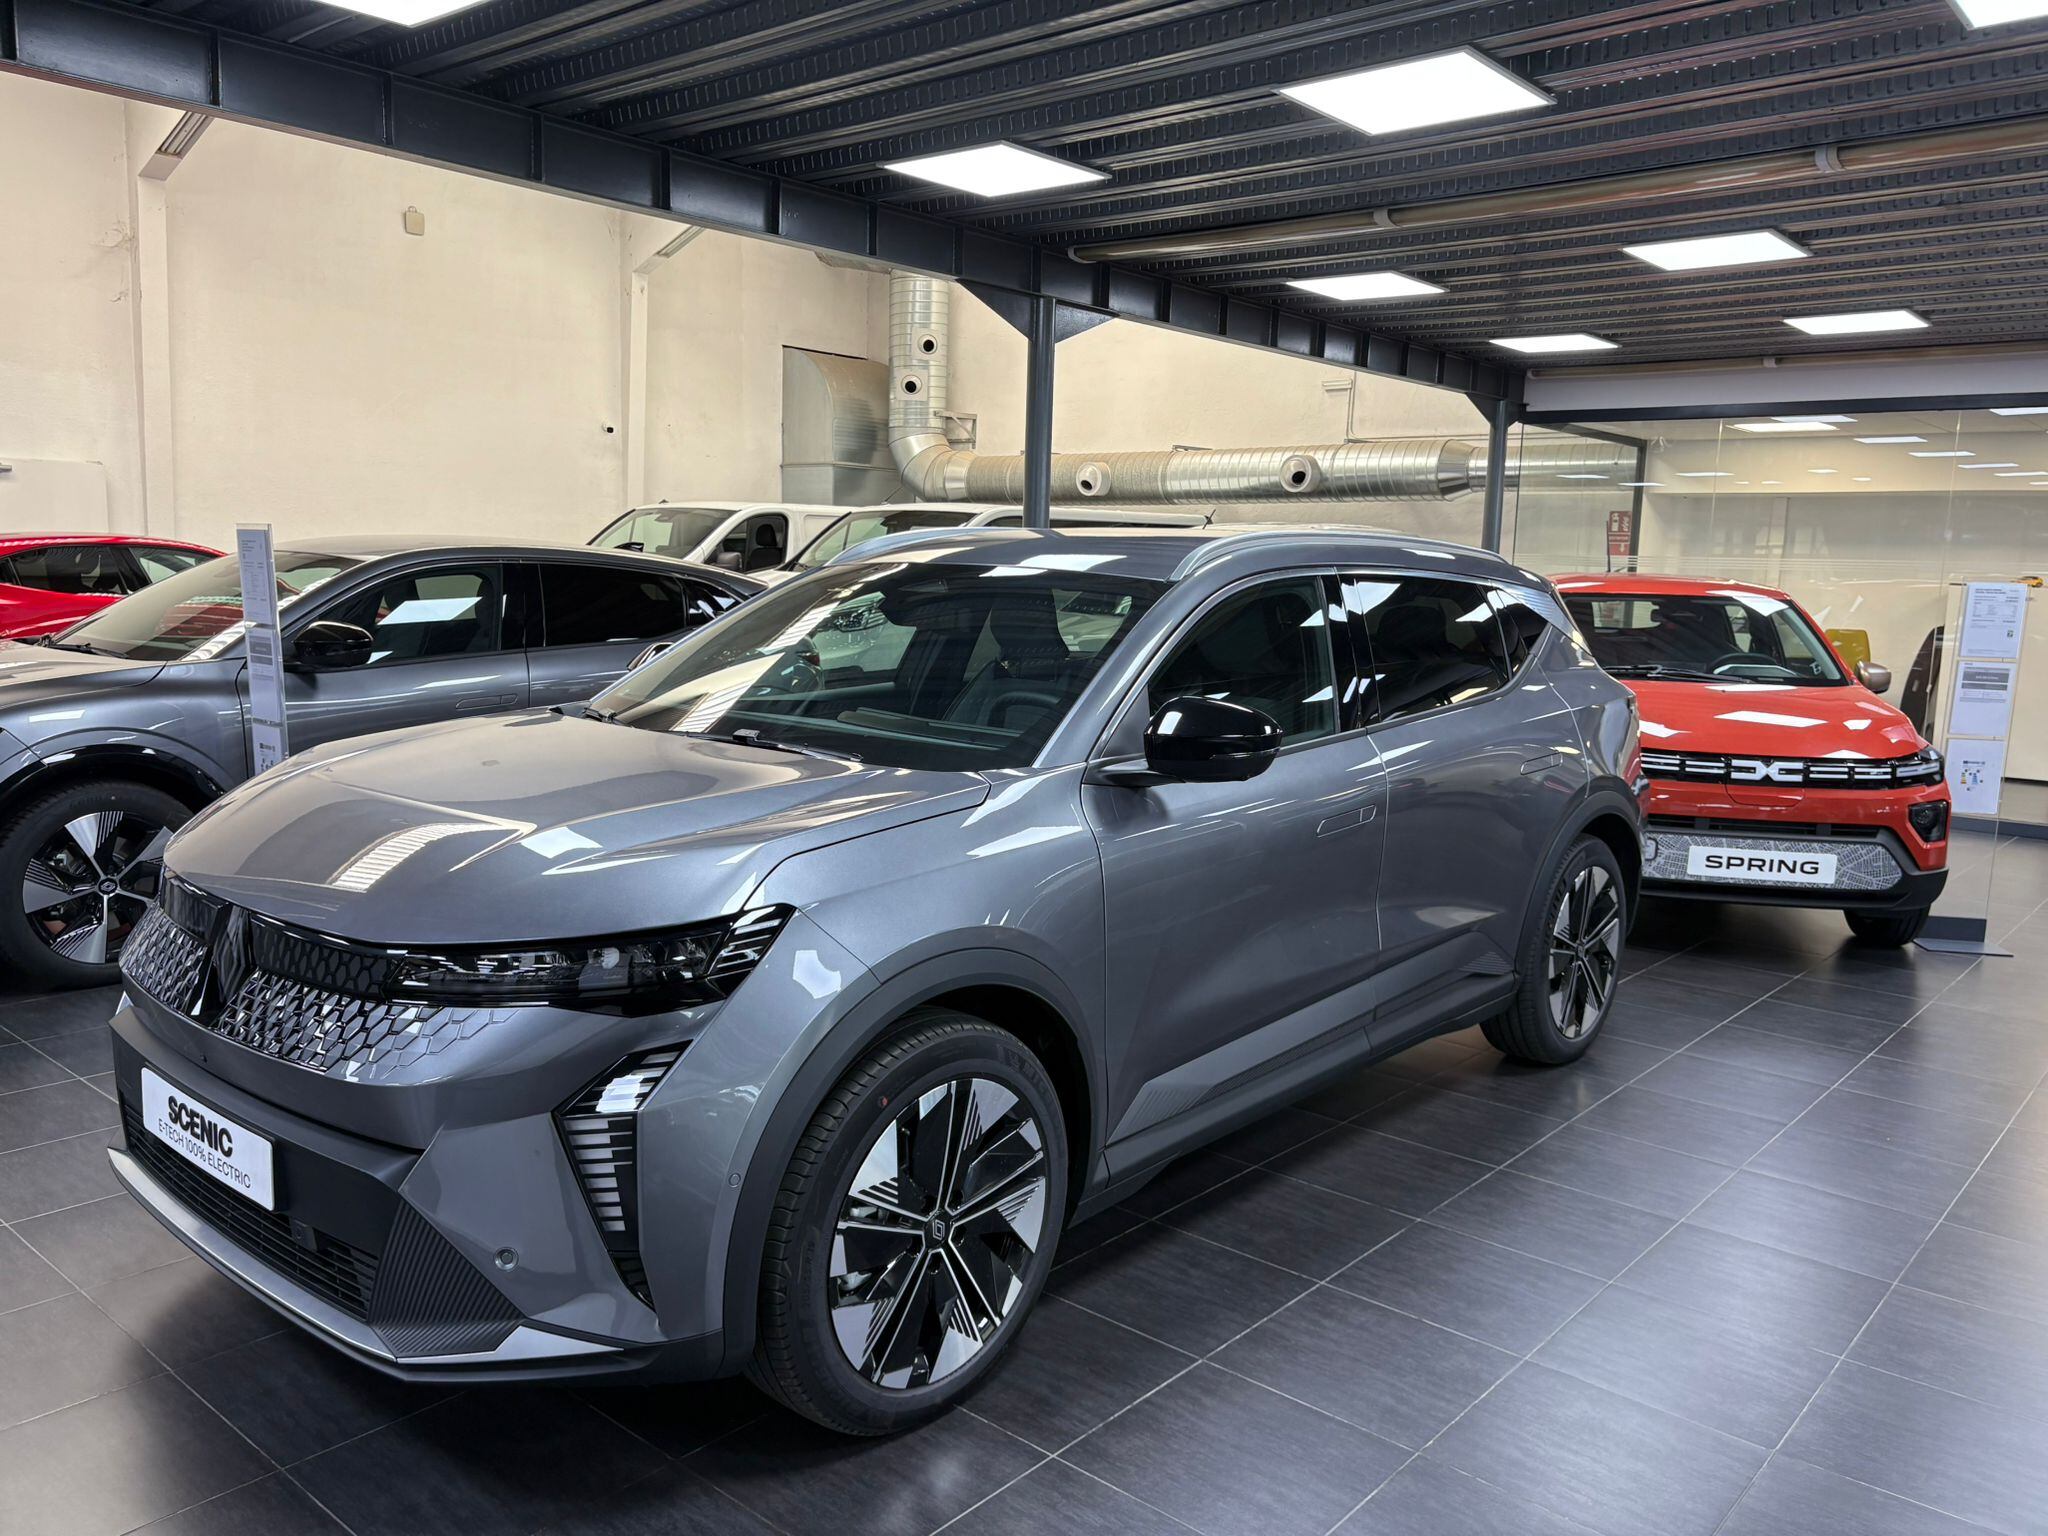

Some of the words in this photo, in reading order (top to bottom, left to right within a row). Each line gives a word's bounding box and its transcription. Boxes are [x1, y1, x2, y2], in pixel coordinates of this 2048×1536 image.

[1705, 855, 1820, 875] SPRING
[158, 1118, 184, 1148] E-TECH
[185, 1136, 207, 1162] 100%
[208, 1151, 251, 1189] ELECTRIC
[168, 1095, 233, 1158] SCENIC
